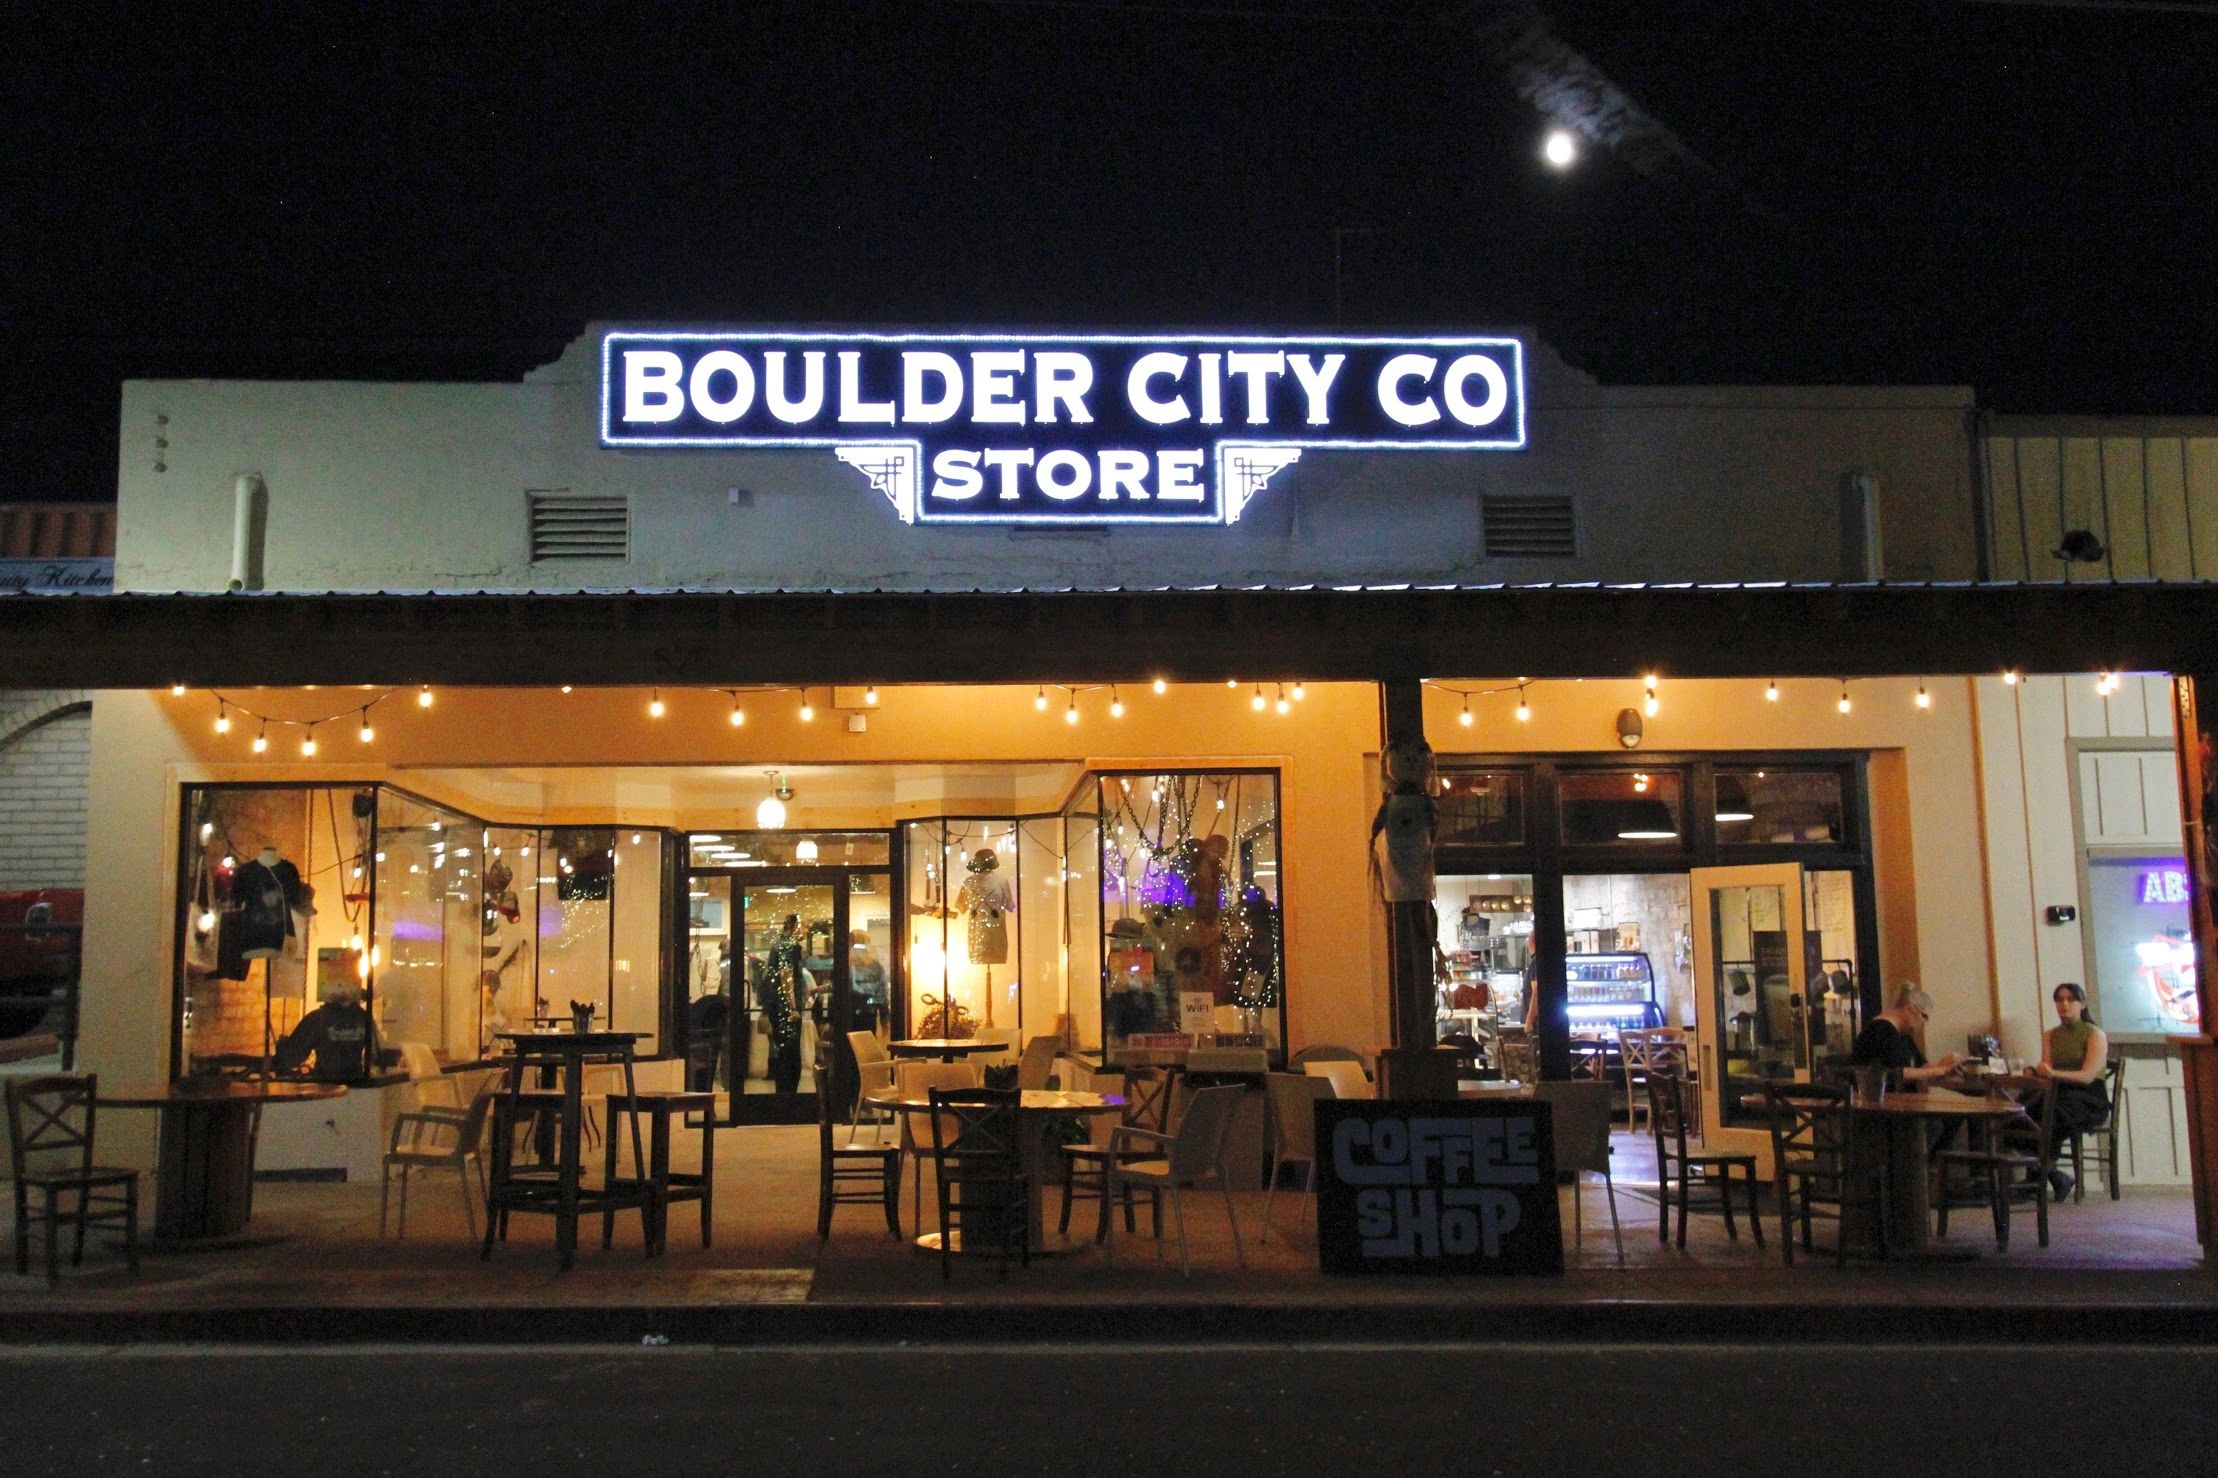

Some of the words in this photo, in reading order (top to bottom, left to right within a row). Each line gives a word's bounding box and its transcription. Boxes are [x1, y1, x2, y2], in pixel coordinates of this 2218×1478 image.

[622, 350, 1094, 424] BOULDER
[1127, 350, 1346, 424] CITY
[1377, 354, 1507, 426] CO
[931, 447, 1204, 502] STORE
[2143, 871, 2189, 902] AB
[1333, 1117, 1538, 1185] COFFEE
[1357, 1188, 1521, 1257] SHOP
